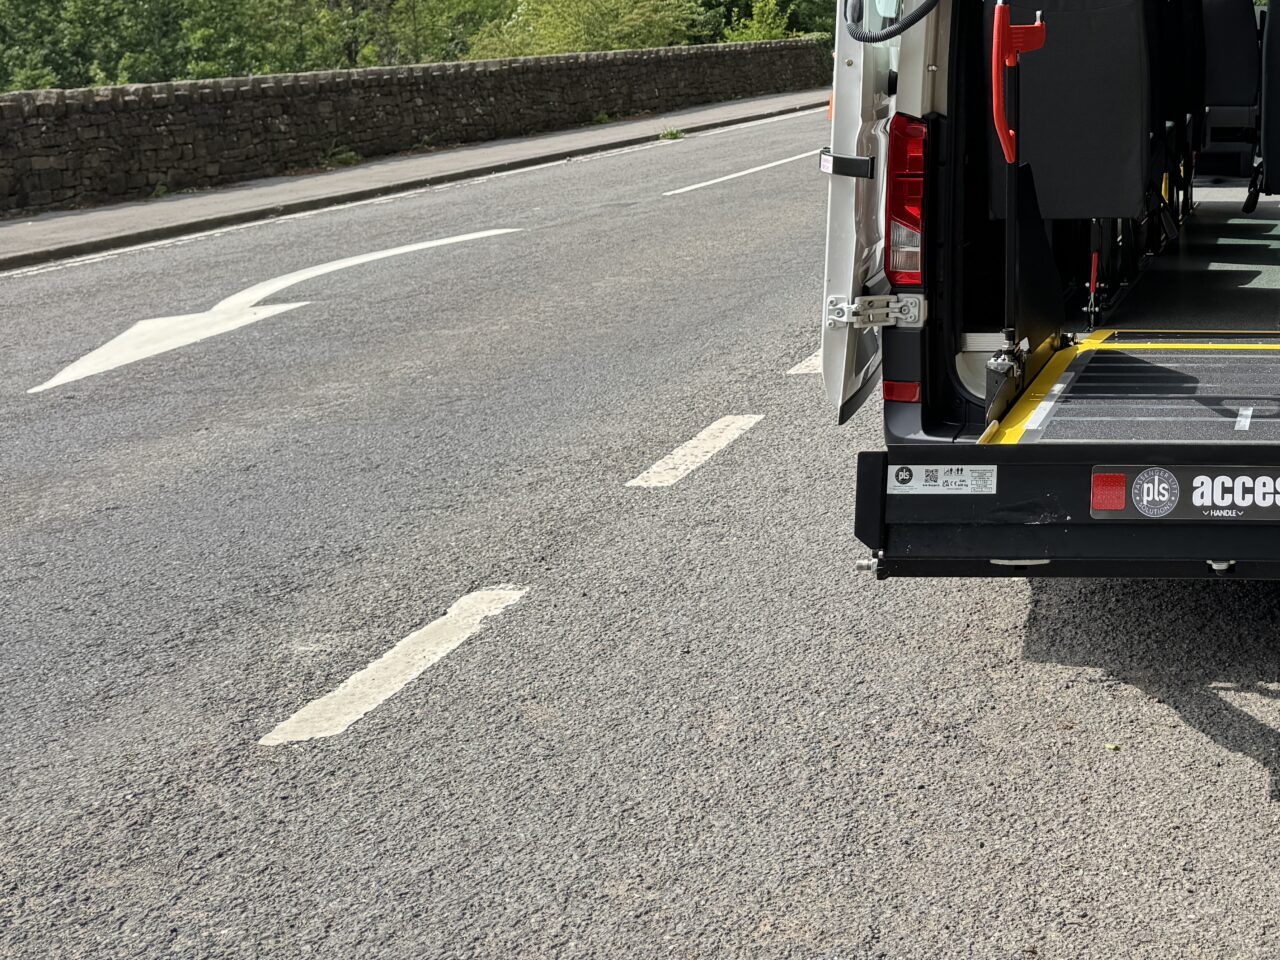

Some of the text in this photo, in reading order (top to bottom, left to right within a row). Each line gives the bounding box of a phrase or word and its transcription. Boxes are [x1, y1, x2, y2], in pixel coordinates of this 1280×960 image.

[1134, 469, 1178, 494] PASSENGER LIFT
[1143, 475, 1169, 505] pls
[1138, 501, 1173, 515] SOLUTIONS
[1210, 509, 1236, 517] HANDLE
